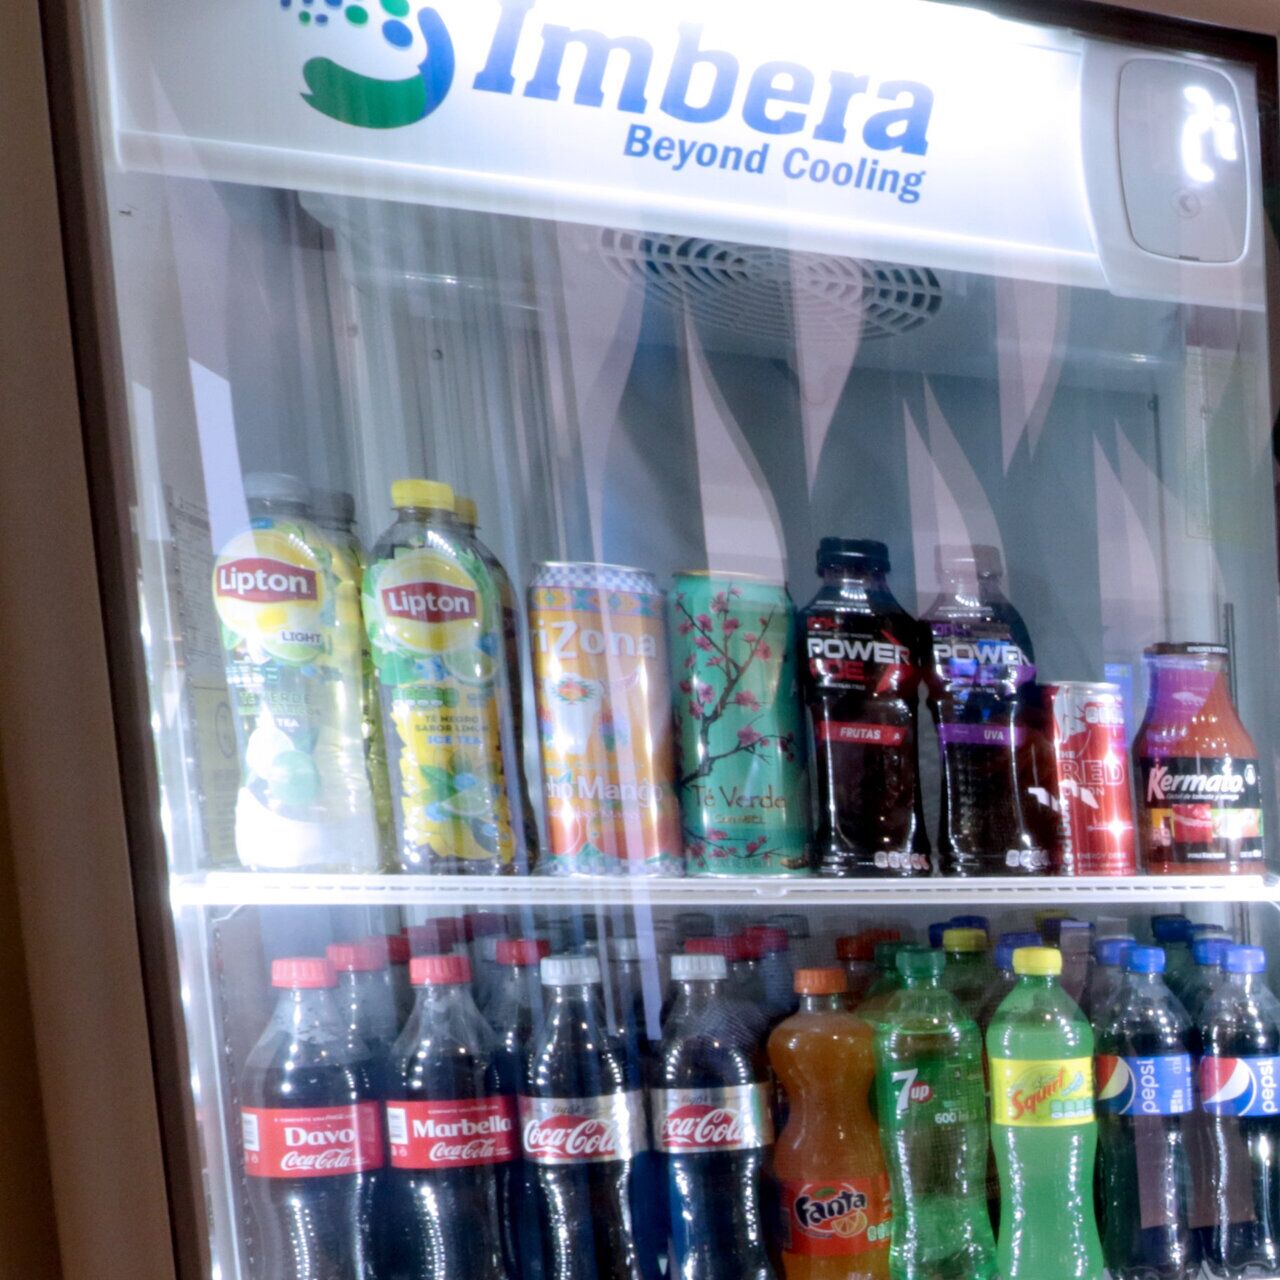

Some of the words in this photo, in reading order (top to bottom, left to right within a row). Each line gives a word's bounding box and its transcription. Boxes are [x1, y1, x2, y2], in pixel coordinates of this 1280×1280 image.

[472, 0, 935, 157] Imbera
[622, 123, 771, 174] Beyond
[781, 146, 927, 204] Cooling
[219, 567, 309, 595] Lipton
[387, 590, 471, 615] Lipton
[281, 631, 322, 644] LIGHT
[839, 726, 881, 740] FRUTAS
[983, 730, 1005, 742] UVA
[718, 784, 787, 809] Verde
[1010, 1066, 1068, 1121] Squirt
[1136, 1058, 1161, 1114] pepsi
[1257, 1058, 1279, 1114] pepsi
[412, 1115, 512, 1138] Marbella
[934, 1112, 957, 1124] 600
[523, 1117, 621, 1156] Coca-Cola
[279, 1149, 353, 1172] Coca-Cola
[428, 1138, 497, 1162] Coca-Cola
[794, 1189, 867, 1226] Fanta
